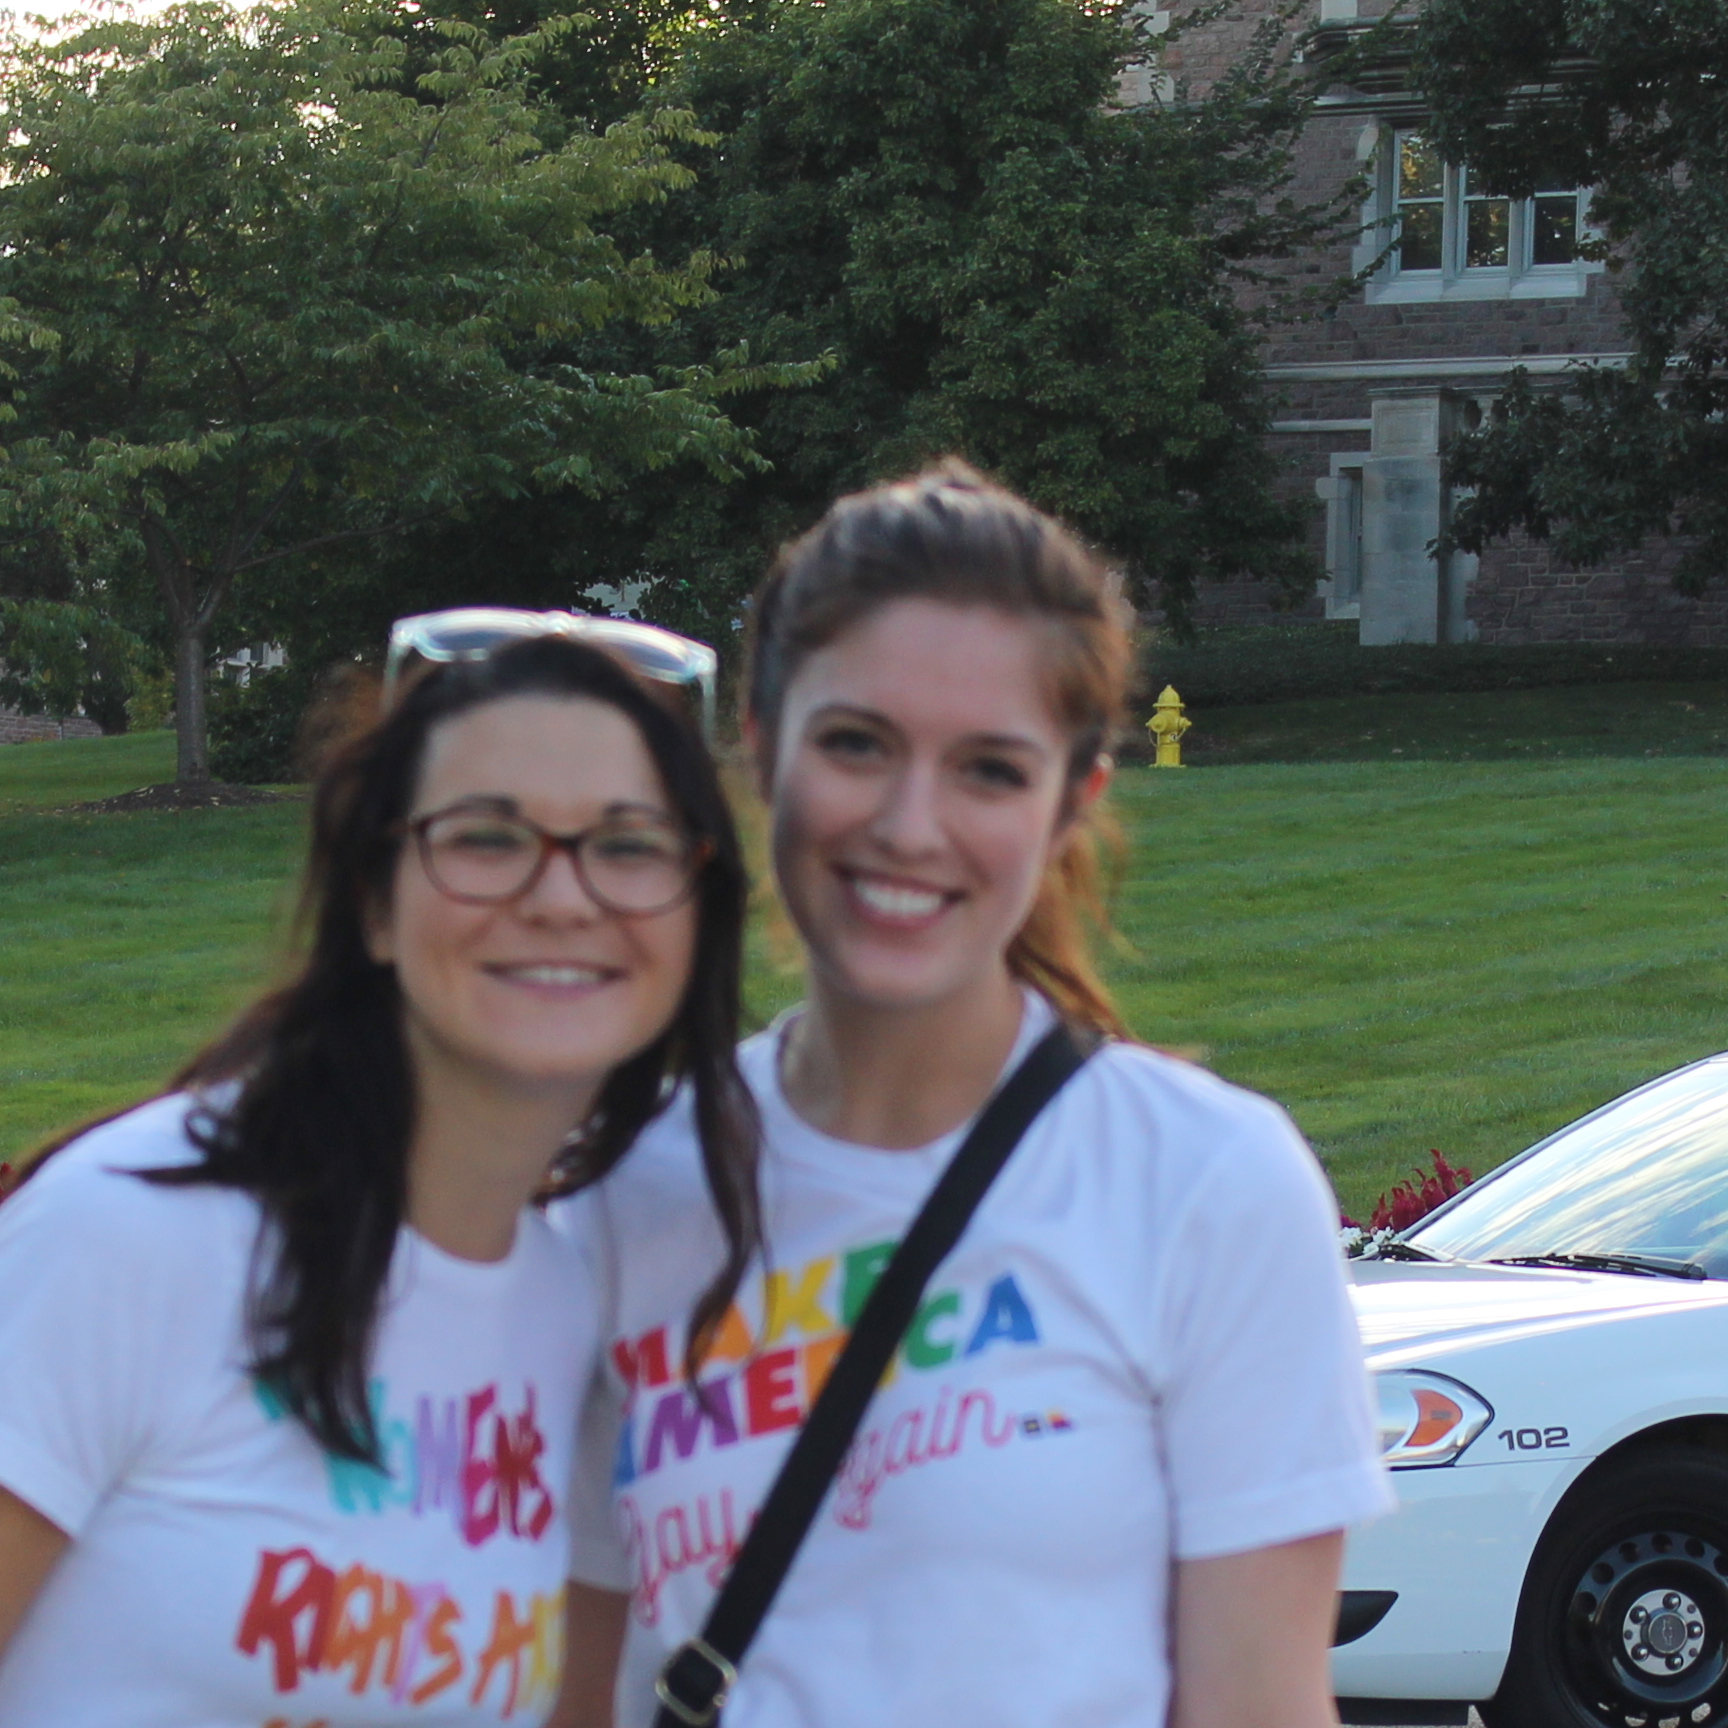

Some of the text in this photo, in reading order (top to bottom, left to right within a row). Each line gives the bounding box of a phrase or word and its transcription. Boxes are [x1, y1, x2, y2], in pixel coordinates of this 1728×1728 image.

[611, 1272, 1039, 1488] MECA
[1498, 1426, 1570, 1451] 102
[833, 1383, 1017, 1532] gain
